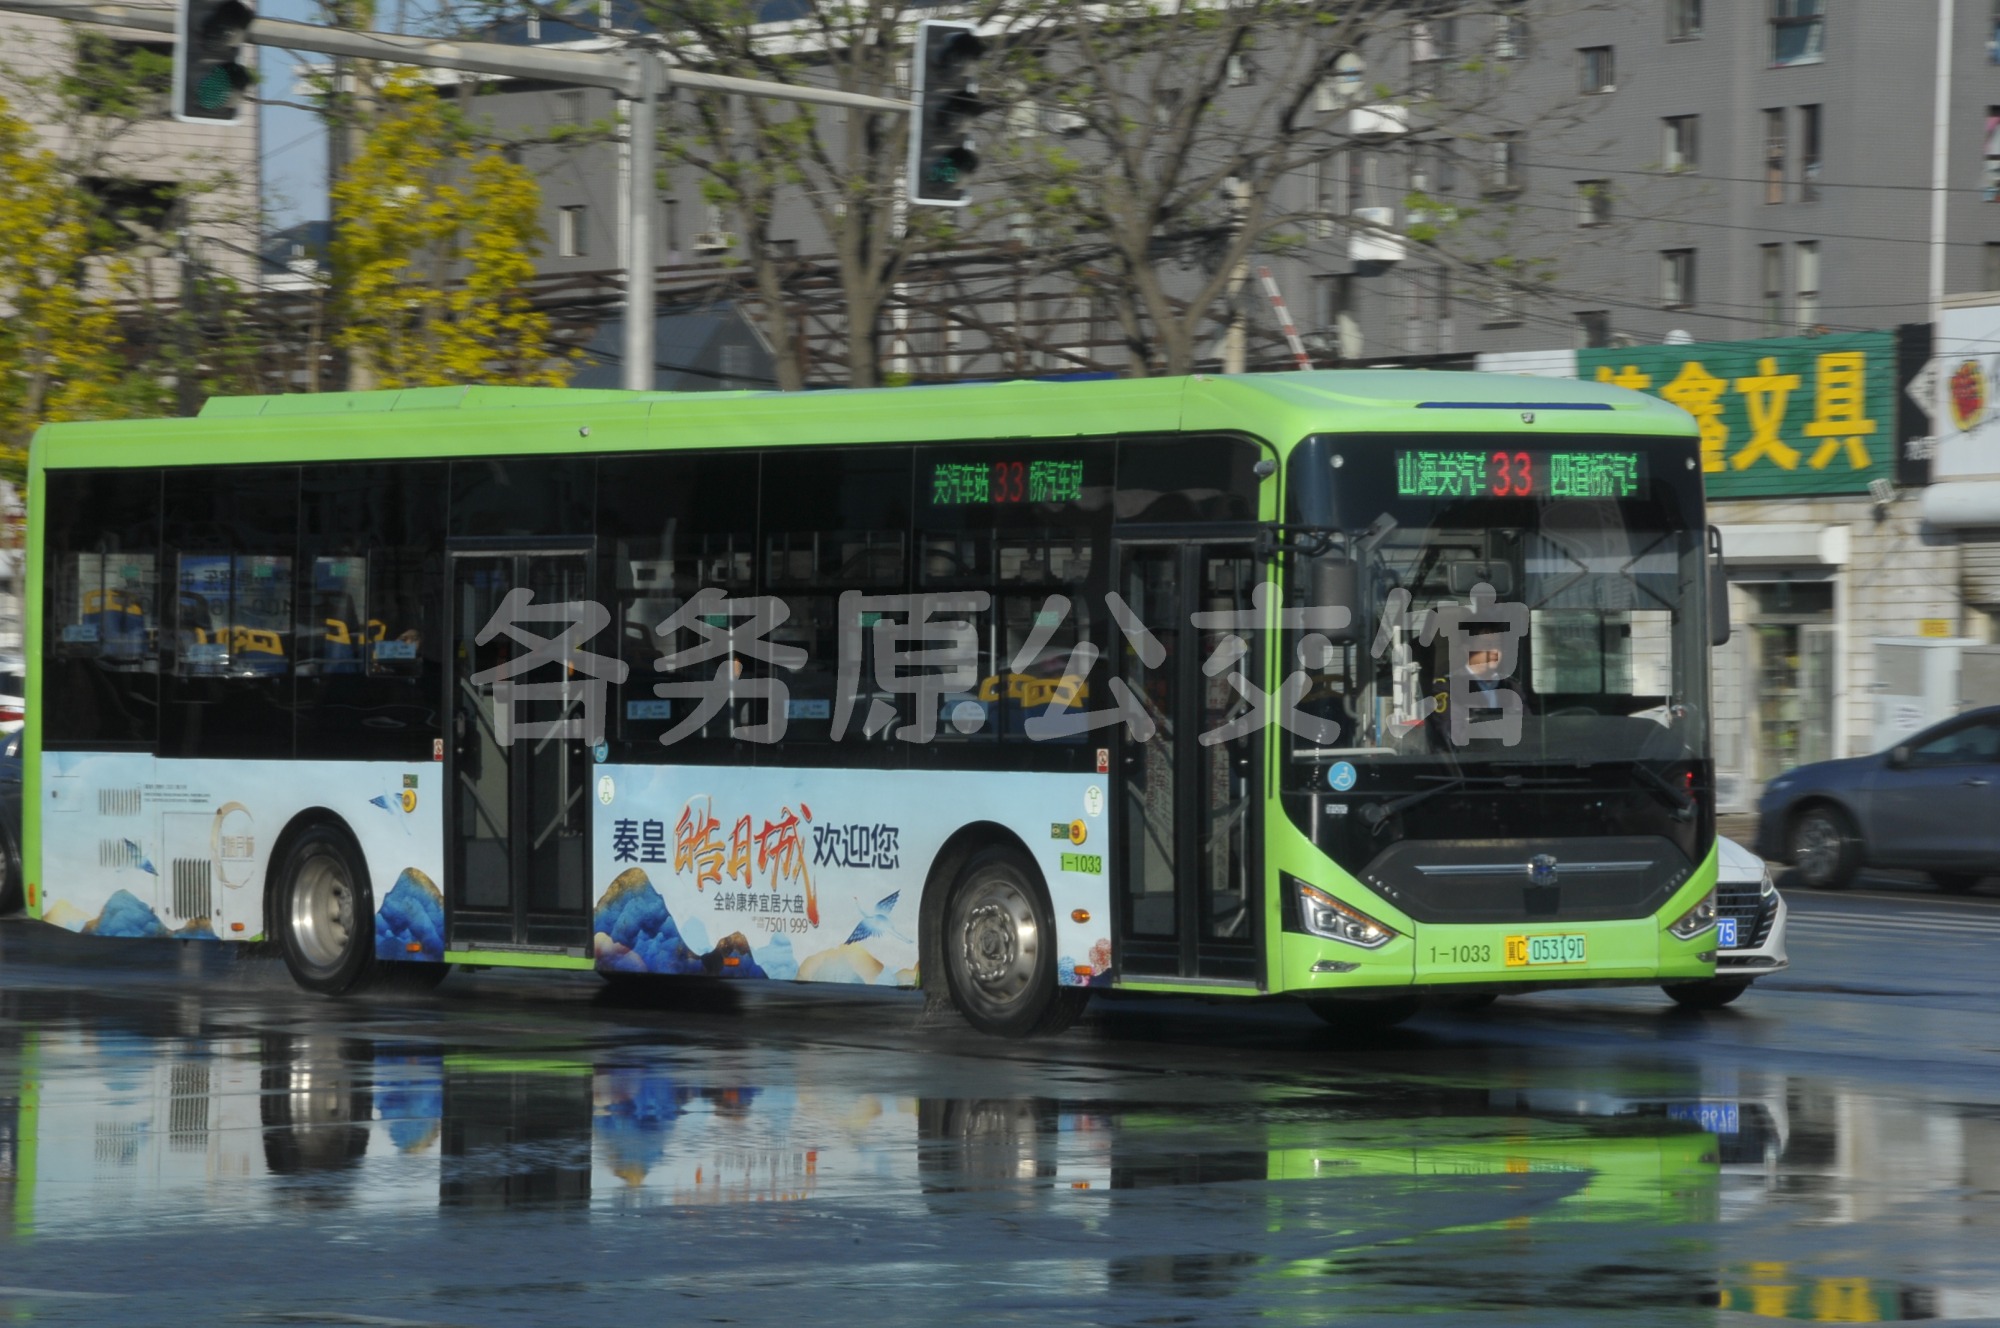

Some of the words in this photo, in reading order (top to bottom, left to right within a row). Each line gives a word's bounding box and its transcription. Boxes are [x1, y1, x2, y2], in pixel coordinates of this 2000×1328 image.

[1596, 350, 1877, 473] 鑫文具
[995, 462, 1024, 502] 33
[1492, 451, 1532, 496] 33
[613, 818, 667, 864] 秦皇
[813, 822, 900, 870] 欢迎您
[1060, 855, 1102, 873] 1-1033
[713, 891, 805, 914] 全龄康养宜居大盘
[764, 917, 787, 933] 7501
[789, 918, 808, 934] 999
[1430, 944, 1491, 963] 1-1033
